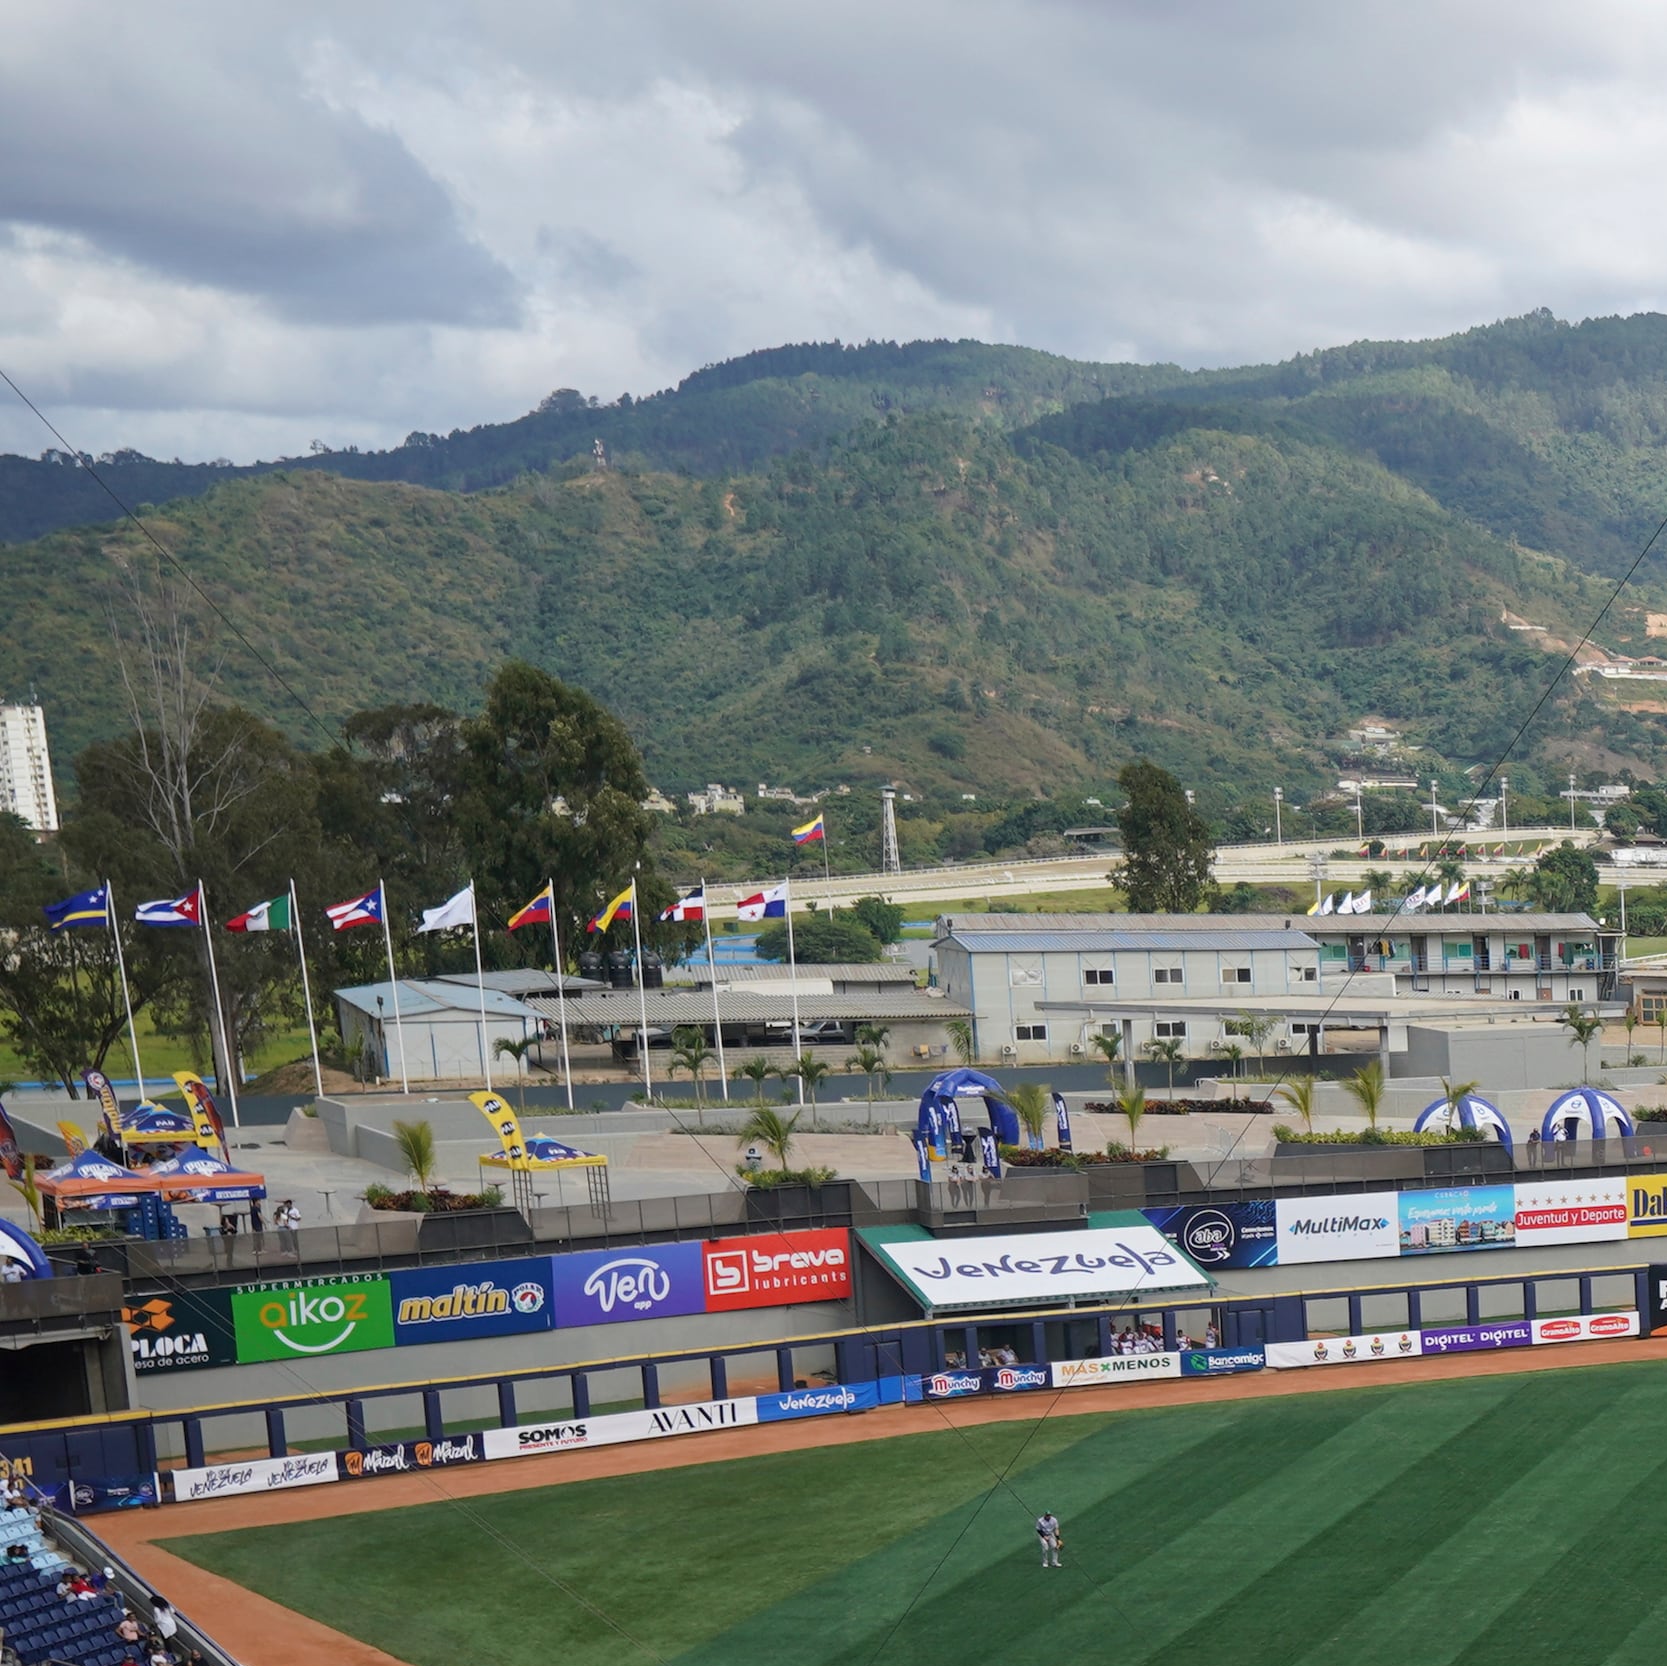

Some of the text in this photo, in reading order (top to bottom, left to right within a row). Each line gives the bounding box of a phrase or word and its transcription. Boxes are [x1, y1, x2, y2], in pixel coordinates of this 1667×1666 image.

[1295, 1217, 1382, 1236] MultiMax
[1517, 1211, 1569, 1228] Juventud
[1570, 1214, 1578, 1226] y
[1581, 1208, 1625, 1224] Deporte
[752, 1247, 845, 1273] brava
[237, 1273, 384, 1295] SUPERMERCADOS
[754, 1271, 848, 1291] lubricants
[259, 1292, 368, 1328] aikoz
[398, 1281, 511, 1325] maltín
[634, 1301, 652, 1311] app
[158, 1355, 174, 1367] de
[175, 1353, 209, 1366] acero
[1113, 1357, 1171, 1372] MENOS
[648, 1402, 737, 1434] AVANTI
